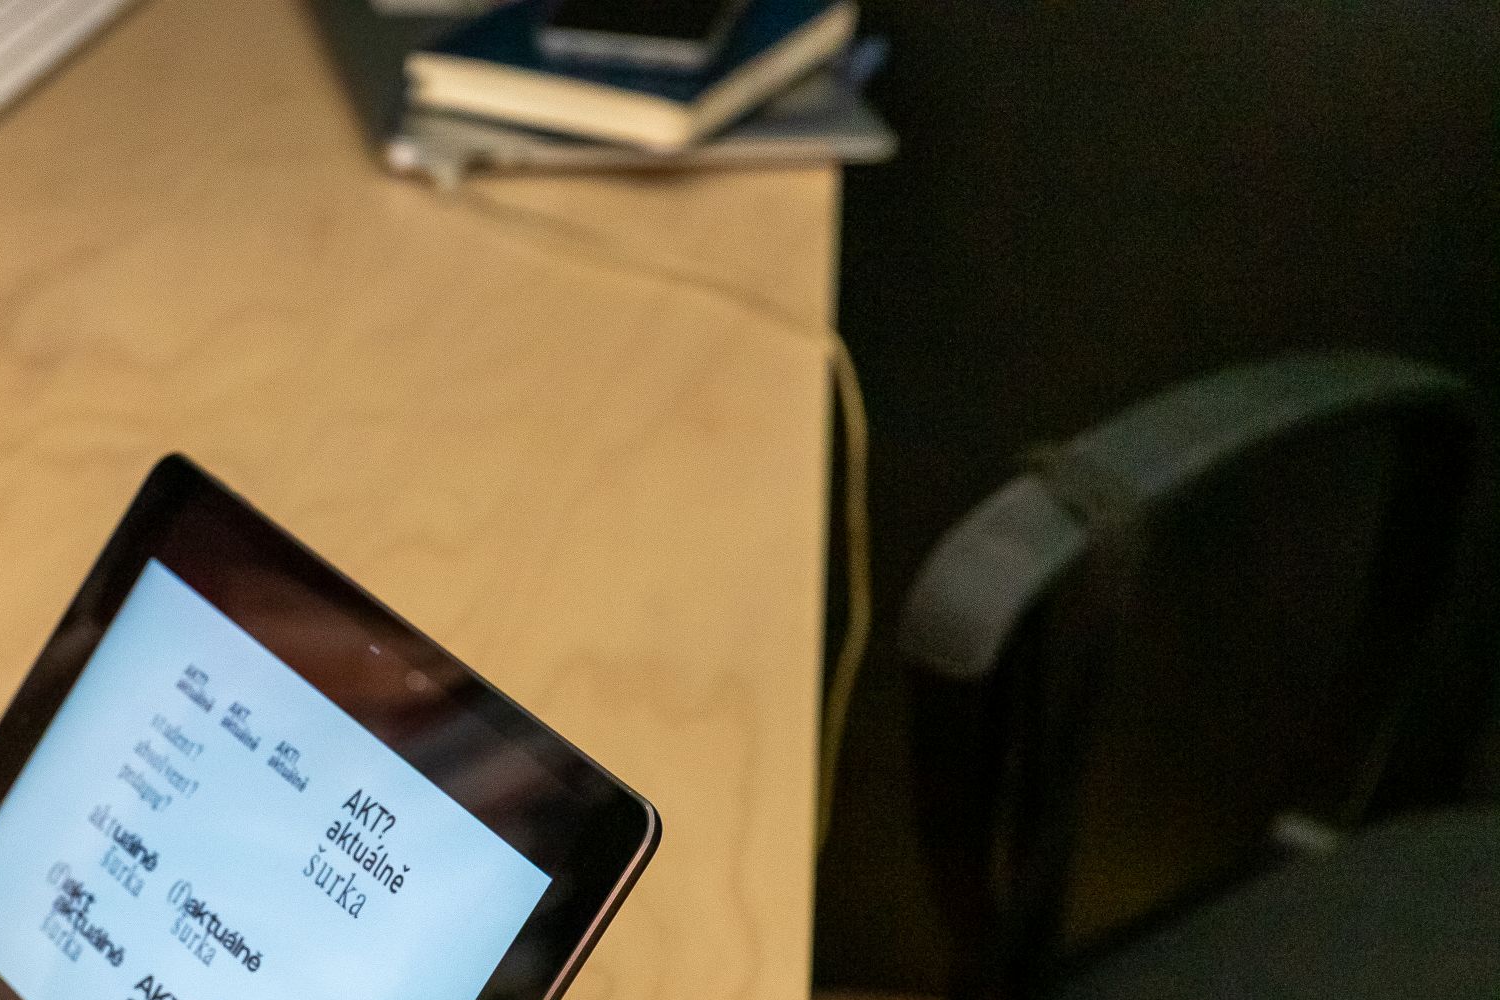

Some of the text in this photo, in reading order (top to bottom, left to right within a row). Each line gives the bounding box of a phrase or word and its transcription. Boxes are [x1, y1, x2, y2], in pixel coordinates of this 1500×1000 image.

[341, 788, 397, 840] AKT?
[302, 844, 367, 919] šurka
[325, 820, 411, 895] aktuálně
